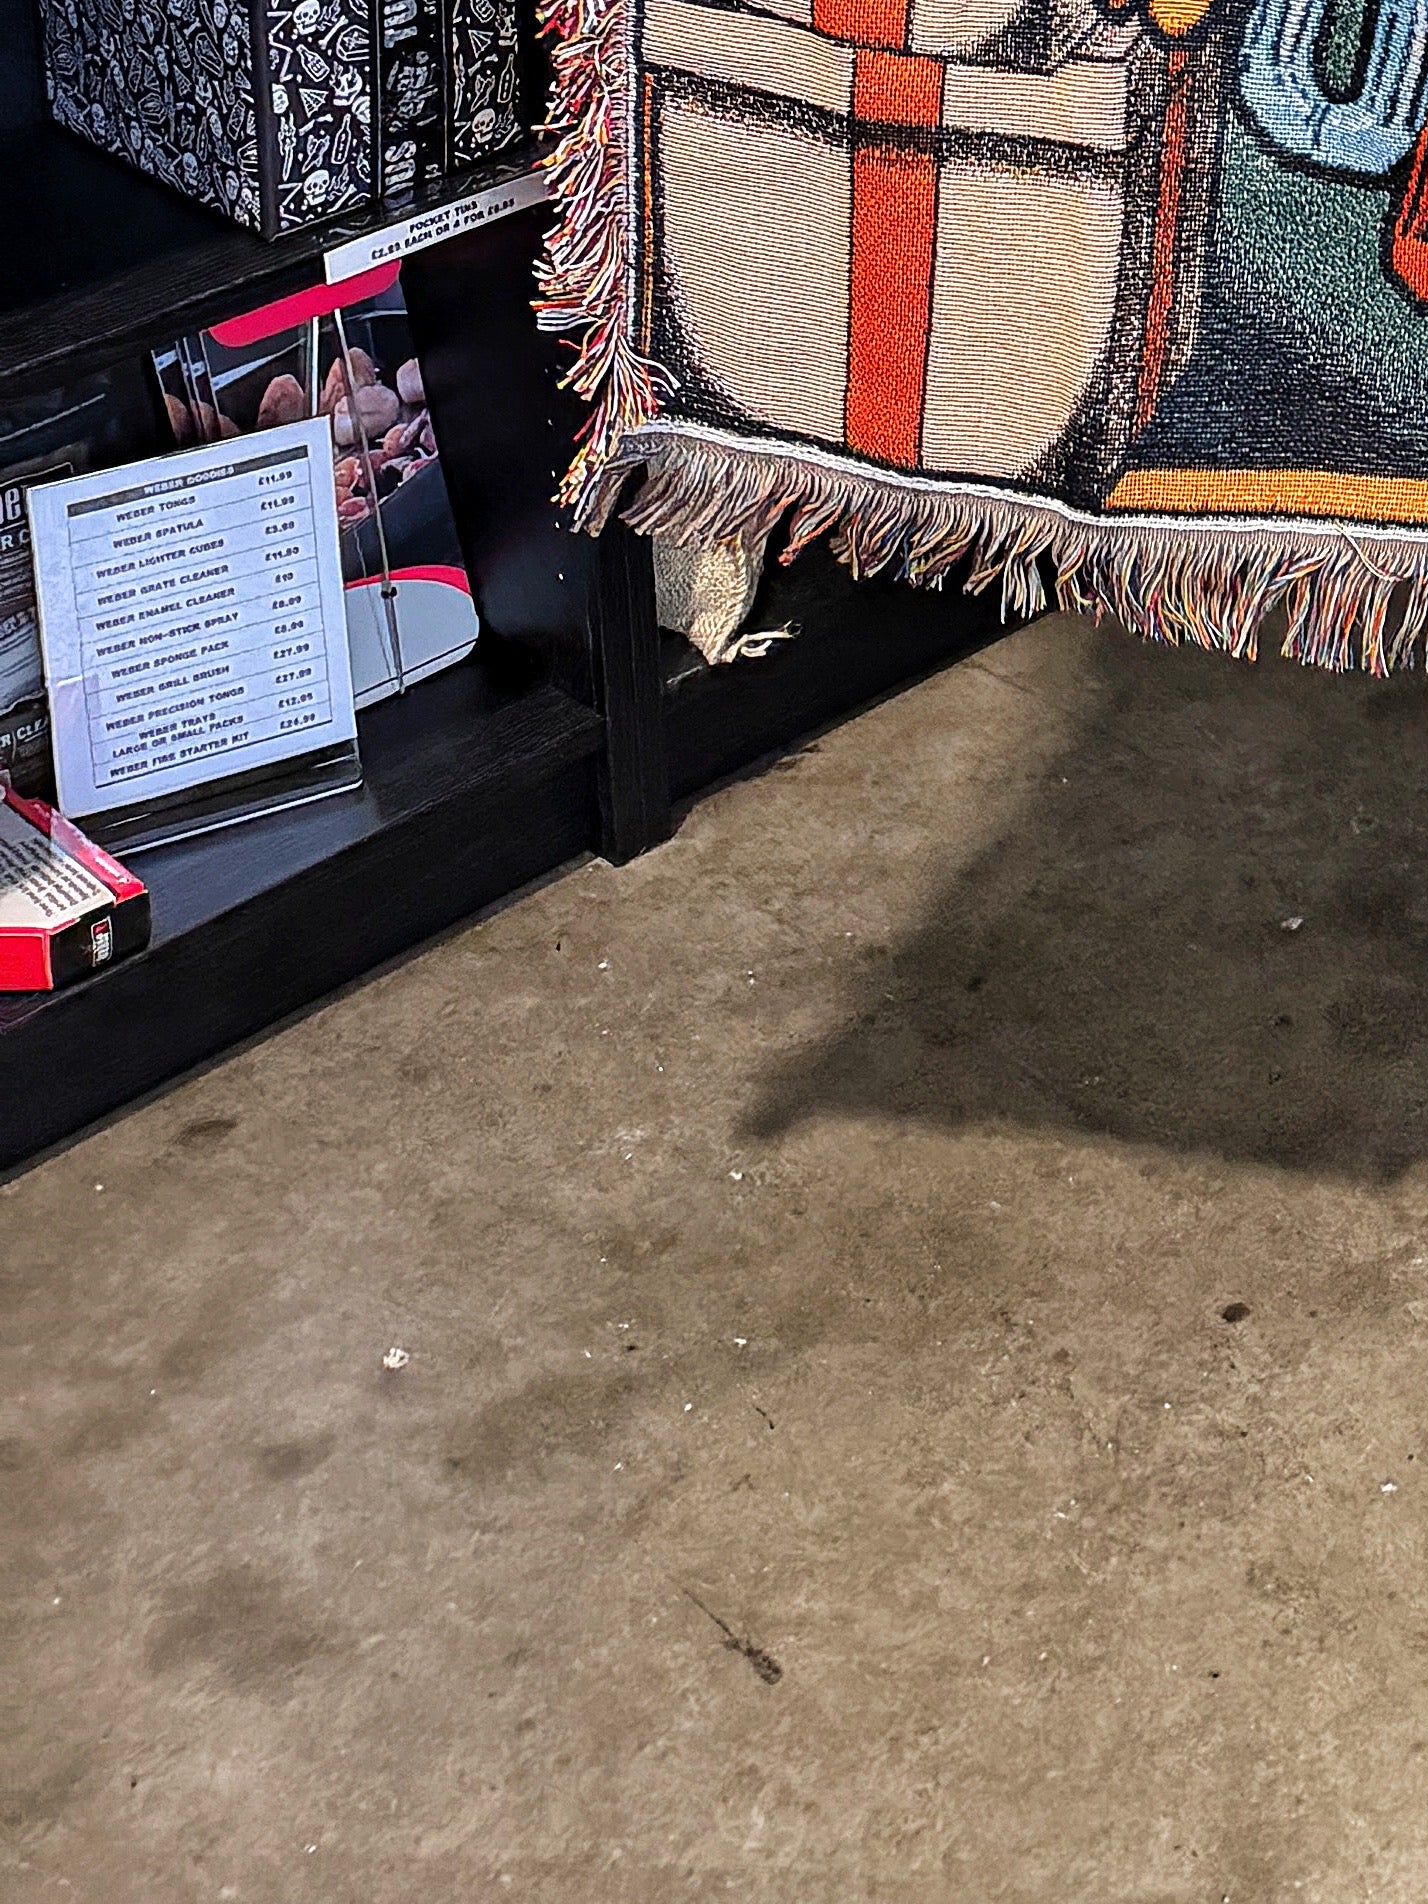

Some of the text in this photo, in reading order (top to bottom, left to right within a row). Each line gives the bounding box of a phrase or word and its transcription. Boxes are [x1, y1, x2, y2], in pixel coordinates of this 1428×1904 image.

[405, 230, 433, 248] EACH
[436, 224, 450, 235] OR
[464, 211, 485, 225] FOR
[409, 201, 478, 233] POCKET TINS
[143, 467, 235, 494] WEBER GOODIES
[117, 506, 155, 523] WEBER
[158, 496, 196, 511] TONGS
[113, 532, 152, 548] WEBER
[156, 519, 204, 538] SPATULA
[97, 538, 224, 578] WEBER LIGHTER CUBES
[97, 565, 229, 605] WEBER GRATE CLEANER
[96, 588, 235, 631] WEBER ENAMEL CLEANER
[97, 612, 239, 656] WEBER NON-STICK SPRAY
[112, 641, 229, 679] WEBER SPONGE PACK
[116, 686, 154, 703] WEBER
[158, 676, 189, 690] GRILL
[193, 665, 230, 682] BRUSH
[106, 714, 144, 731] WEBER
[148, 698, 205, 719] PRECISION
[209, 686, 244, 702] TONGS
[139, 723, 177, 740] WEBER
[181, 713, 216, 729] TRAYS
[110, 732, 249, 777] WEBER FIRE STARTER KIT
[112, 715, 243, 758] LARGE OR SMALL PACKS
